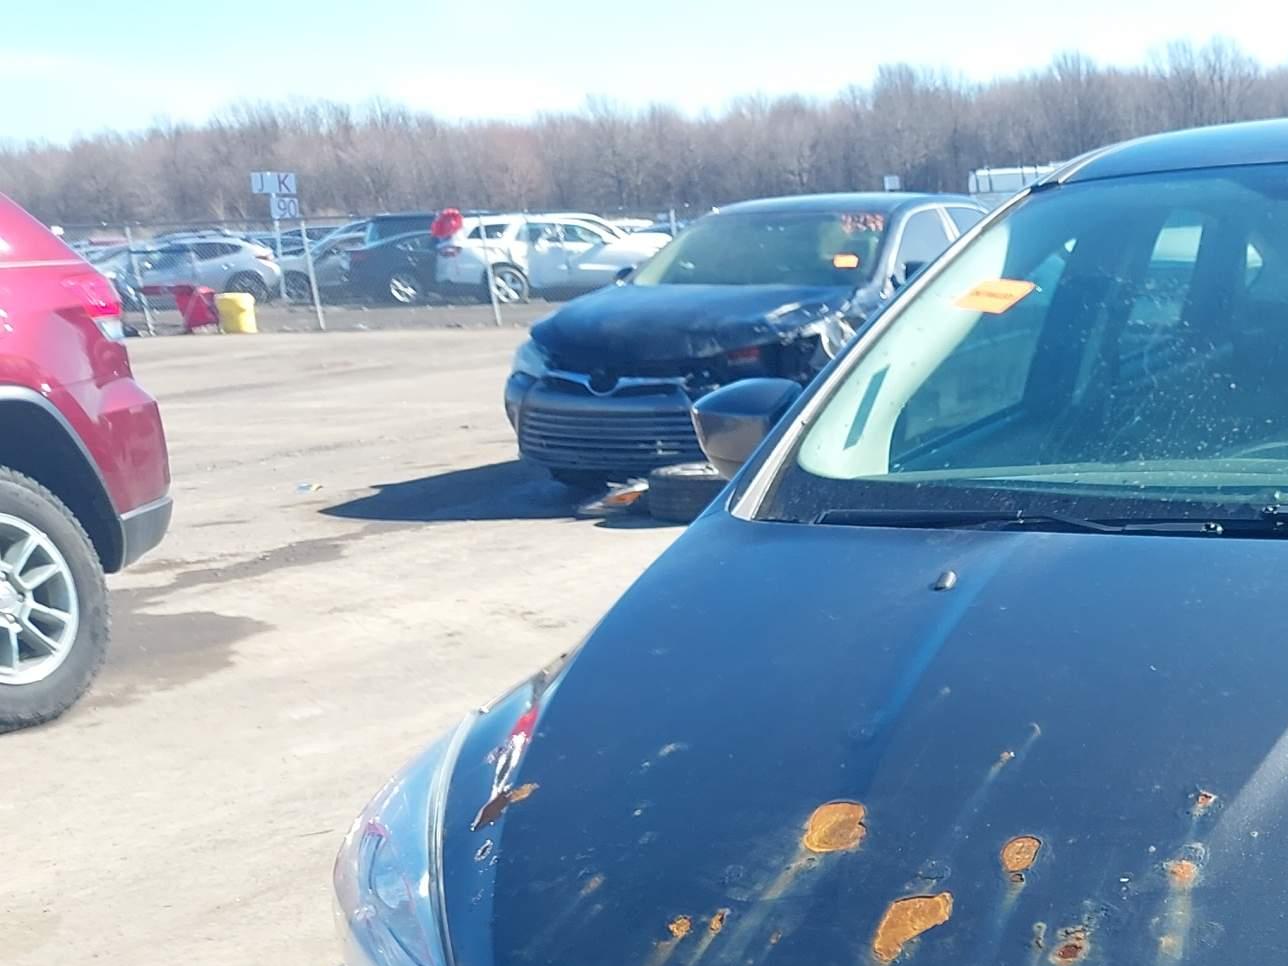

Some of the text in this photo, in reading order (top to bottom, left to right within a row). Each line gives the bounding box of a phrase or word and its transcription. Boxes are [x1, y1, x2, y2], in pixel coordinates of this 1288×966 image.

[258, 174, 292, 193] J K
[277, 199, 298, 218] 90
